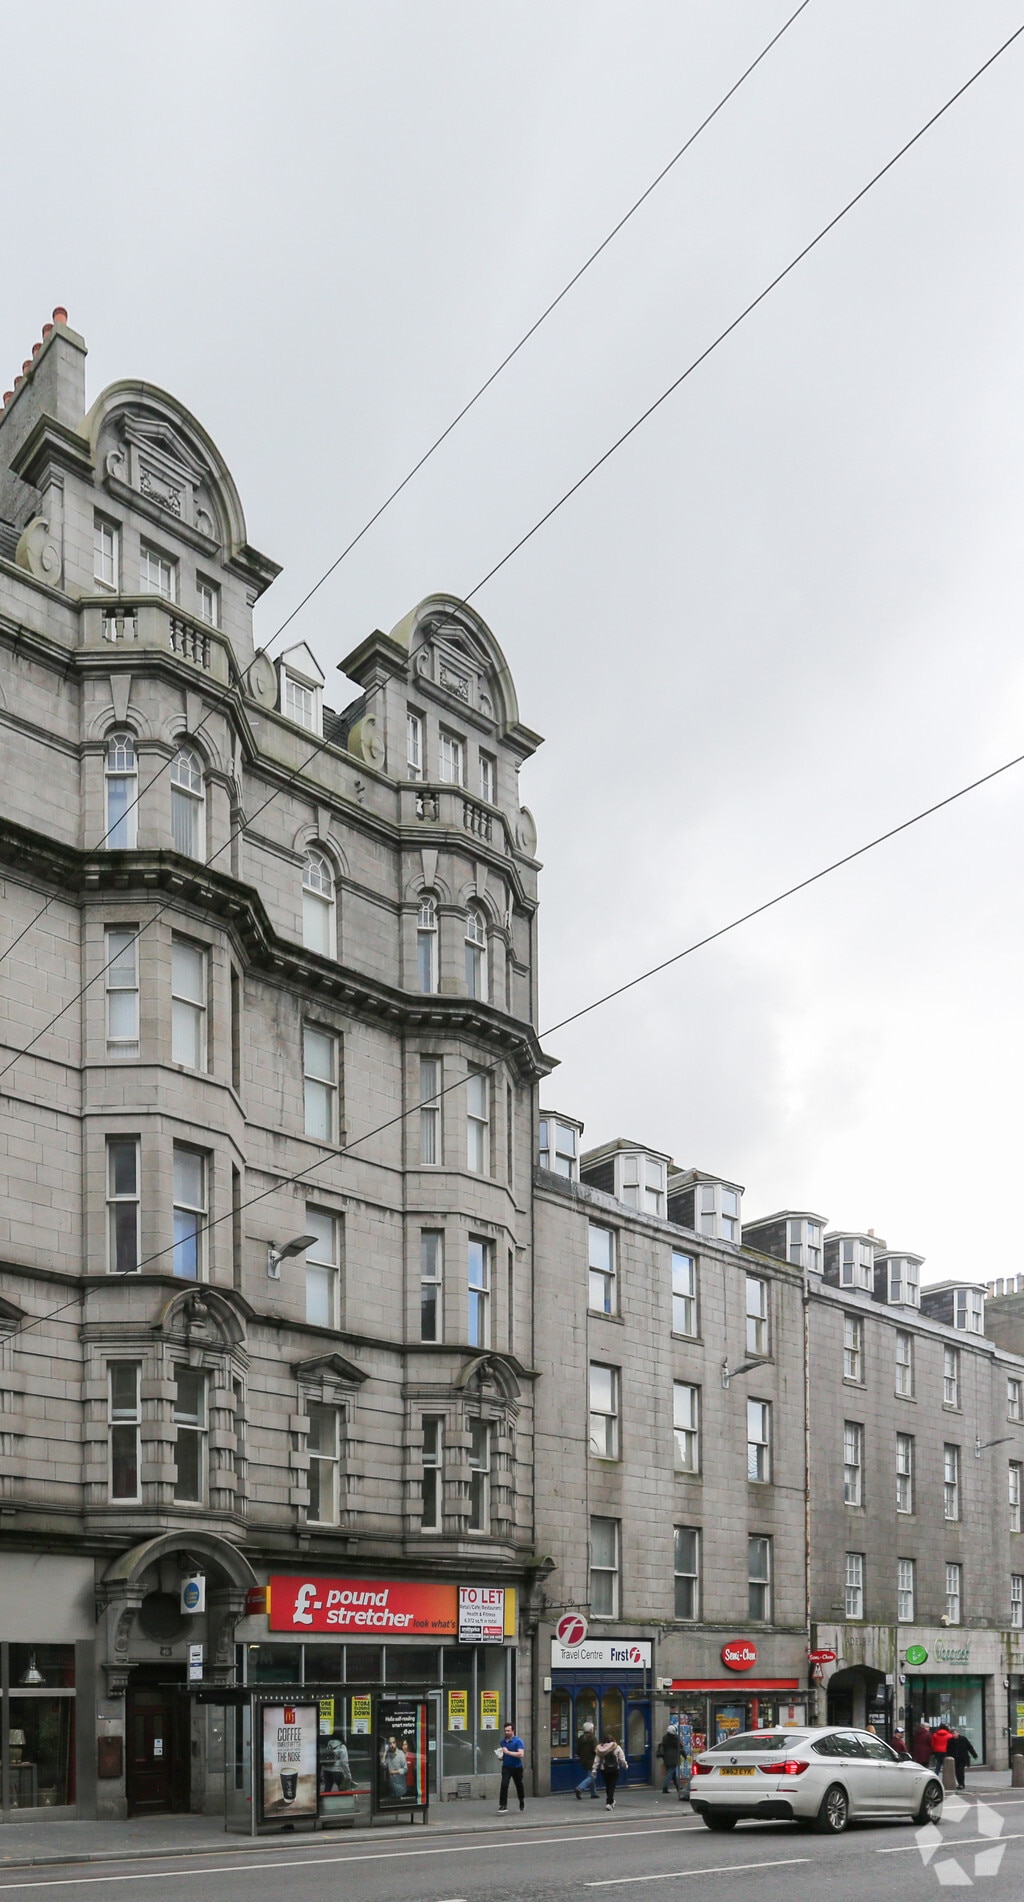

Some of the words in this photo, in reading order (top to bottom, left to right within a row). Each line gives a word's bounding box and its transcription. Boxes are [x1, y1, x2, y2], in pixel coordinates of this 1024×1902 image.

[326, 1589, 389, 1607] pound
[460, 1588, 478, 1603] TO
[481, 1589, 503, 1604] LET
[326, 1607, 414, 1627] stretcher
[413, 1619, 429, 1628] look
[431, 1620, 456, 1628] what's
[561, 1649, 580, 1660] Travel
[581, 1649, 603, 1660] Centre
[610, 1647, 629, 1661] First
[277, 1727, 302, 1741] COFFEE
[277, 1752, 288, 1763] THE
